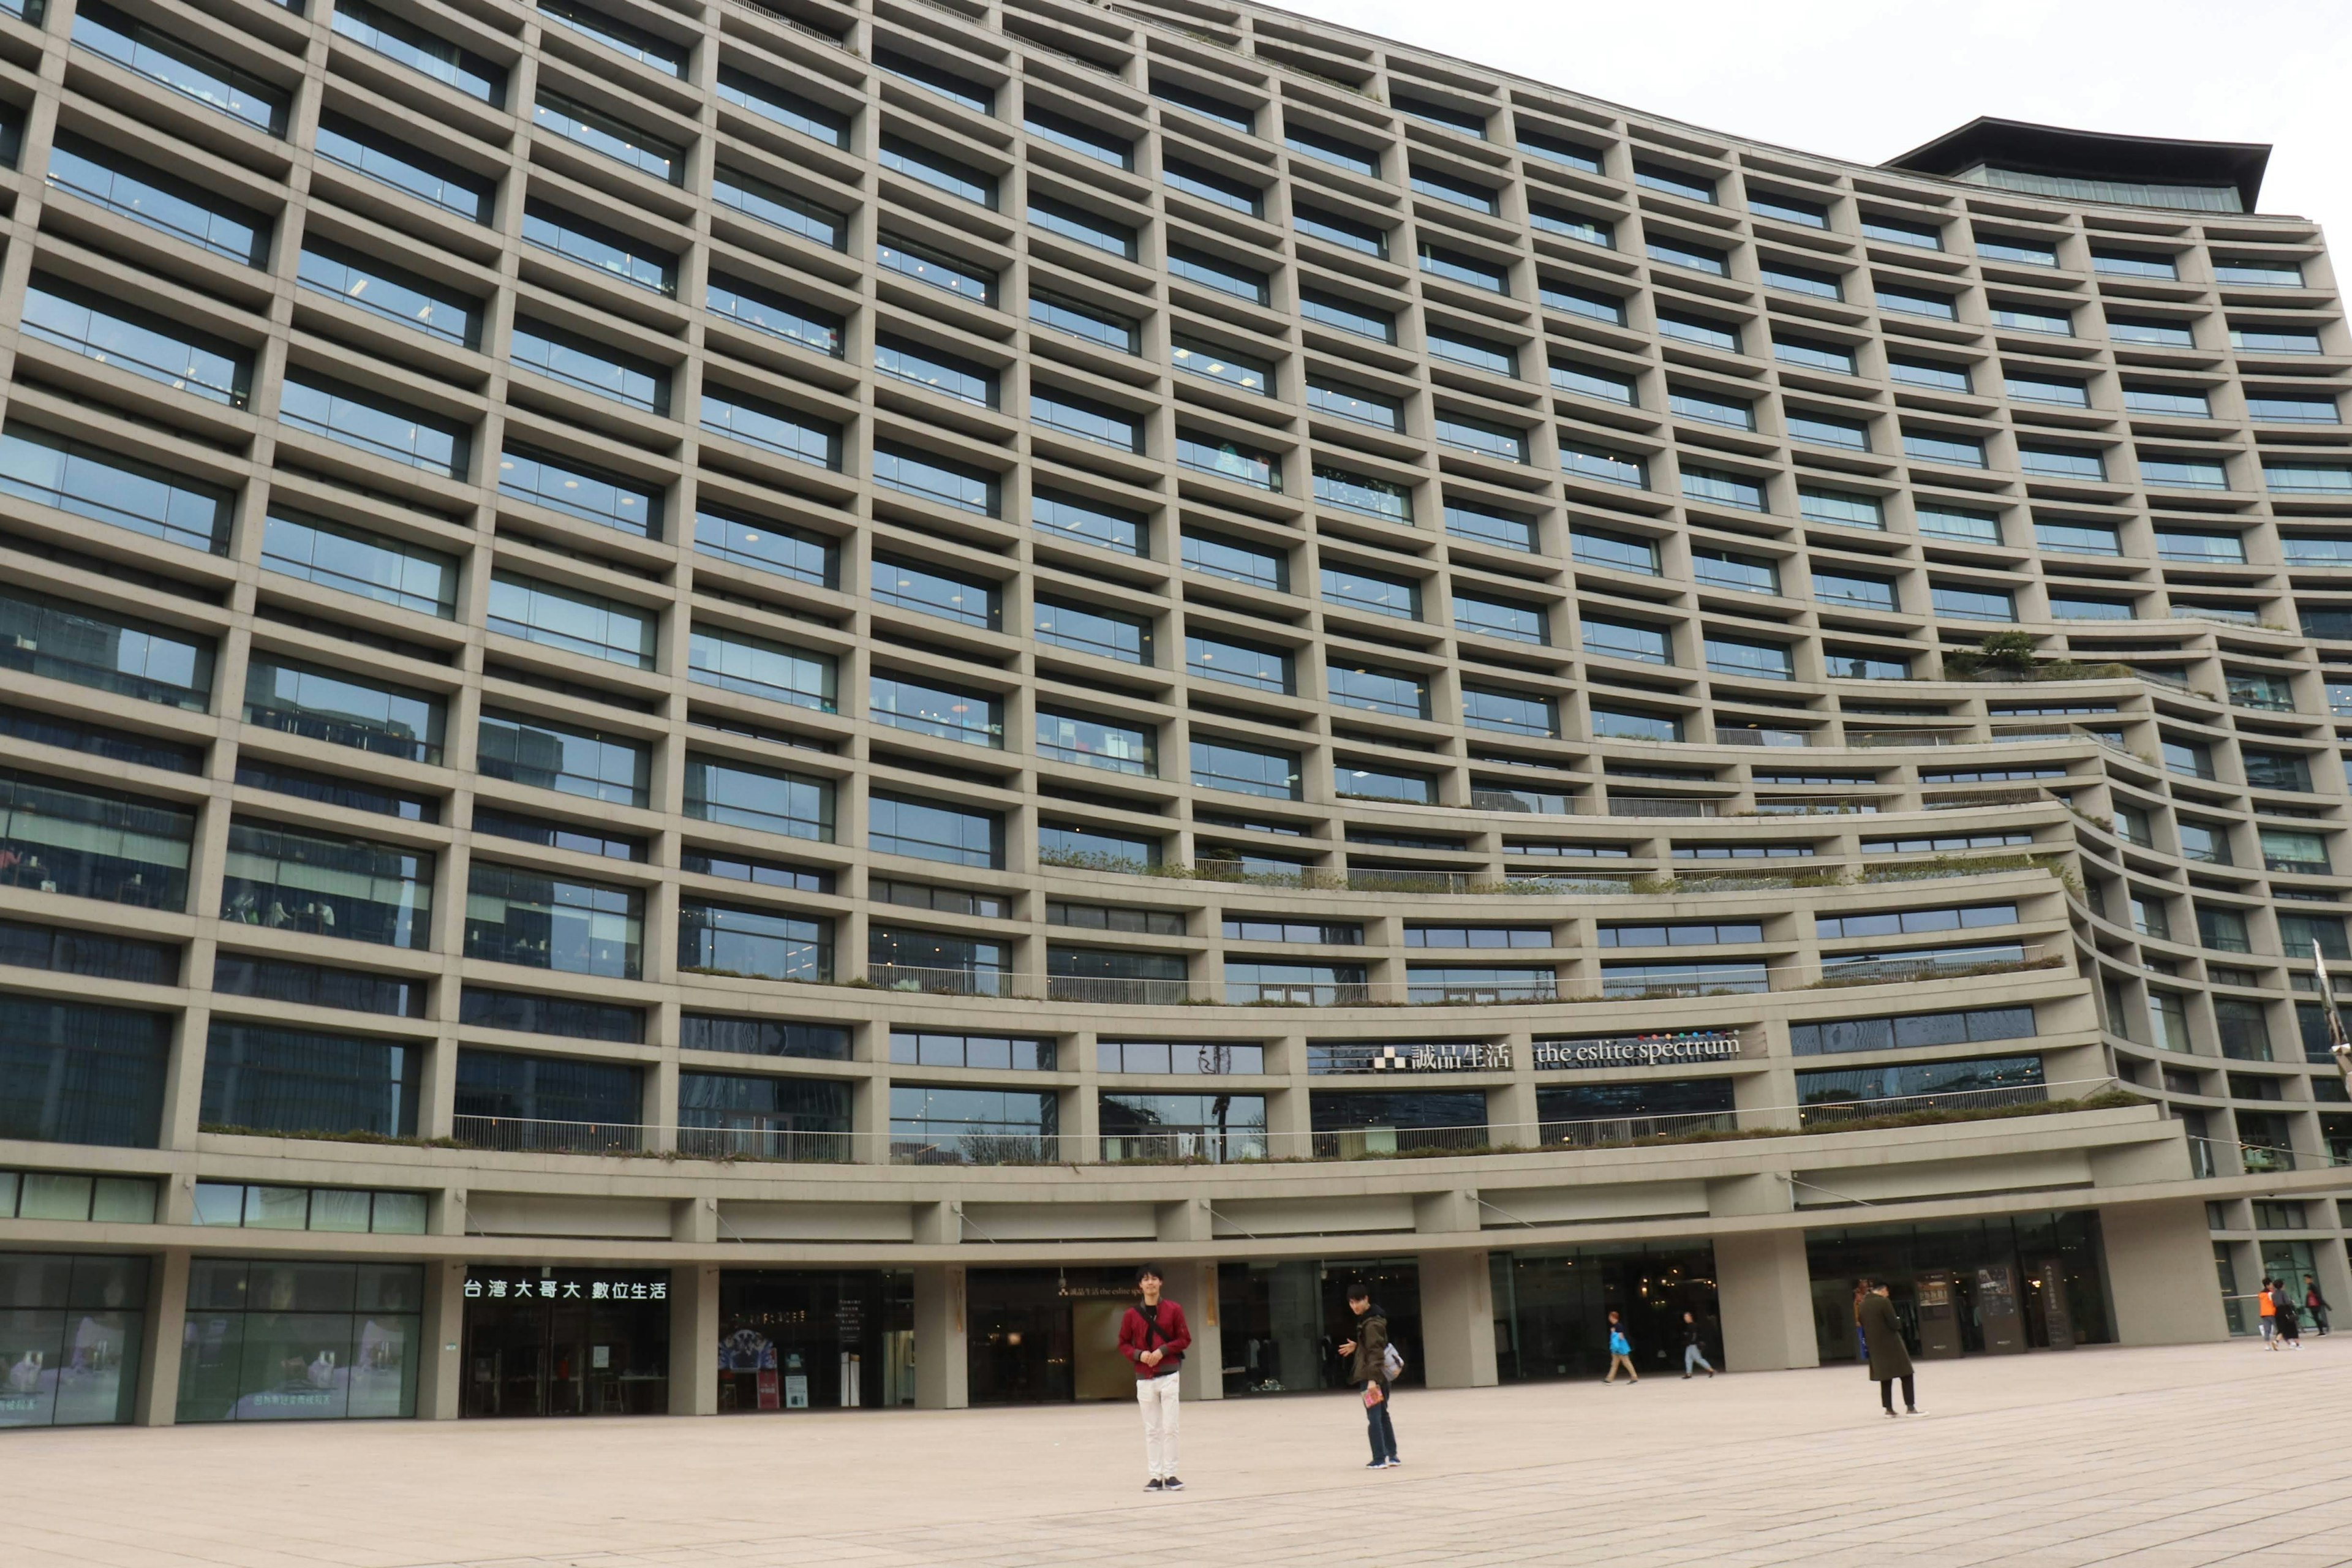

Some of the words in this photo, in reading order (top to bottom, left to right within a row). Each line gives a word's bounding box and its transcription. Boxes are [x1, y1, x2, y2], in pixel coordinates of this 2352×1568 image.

[1411, 1043, 1510, 1069] 誠品生活
[1536, 1042, 1571, 1063] the
[1575, 1040, 1635, 1060] eslite
[1638, 1038, 1741, 1065] spectrum
[592, 1281, 666, 1299] 數位生活
